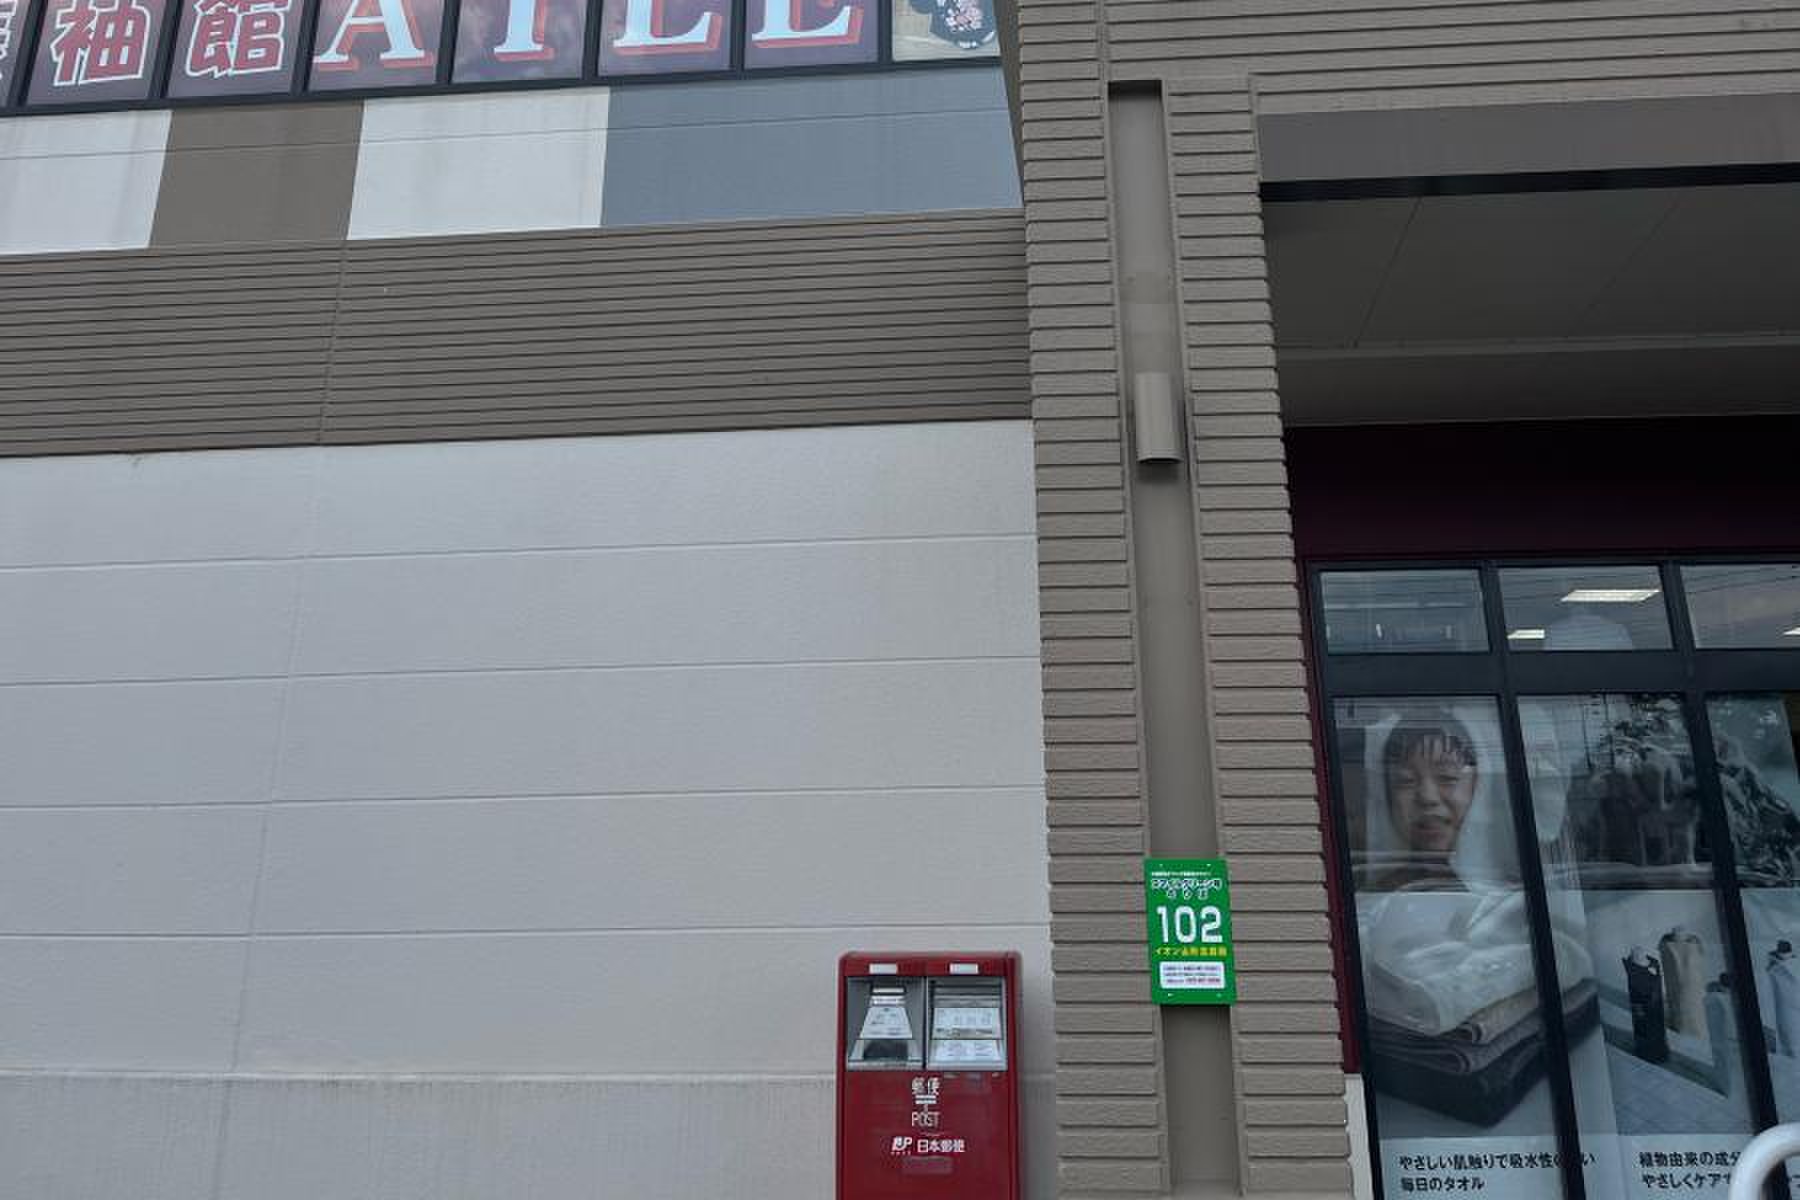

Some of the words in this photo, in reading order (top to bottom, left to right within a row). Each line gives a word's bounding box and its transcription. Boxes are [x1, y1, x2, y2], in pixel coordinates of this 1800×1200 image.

[1157, 905, 1223, 943] 102
[911, 1111, 941, 1128] POST
[1401, 1176, 1485, 1192] 毎日のタオル
